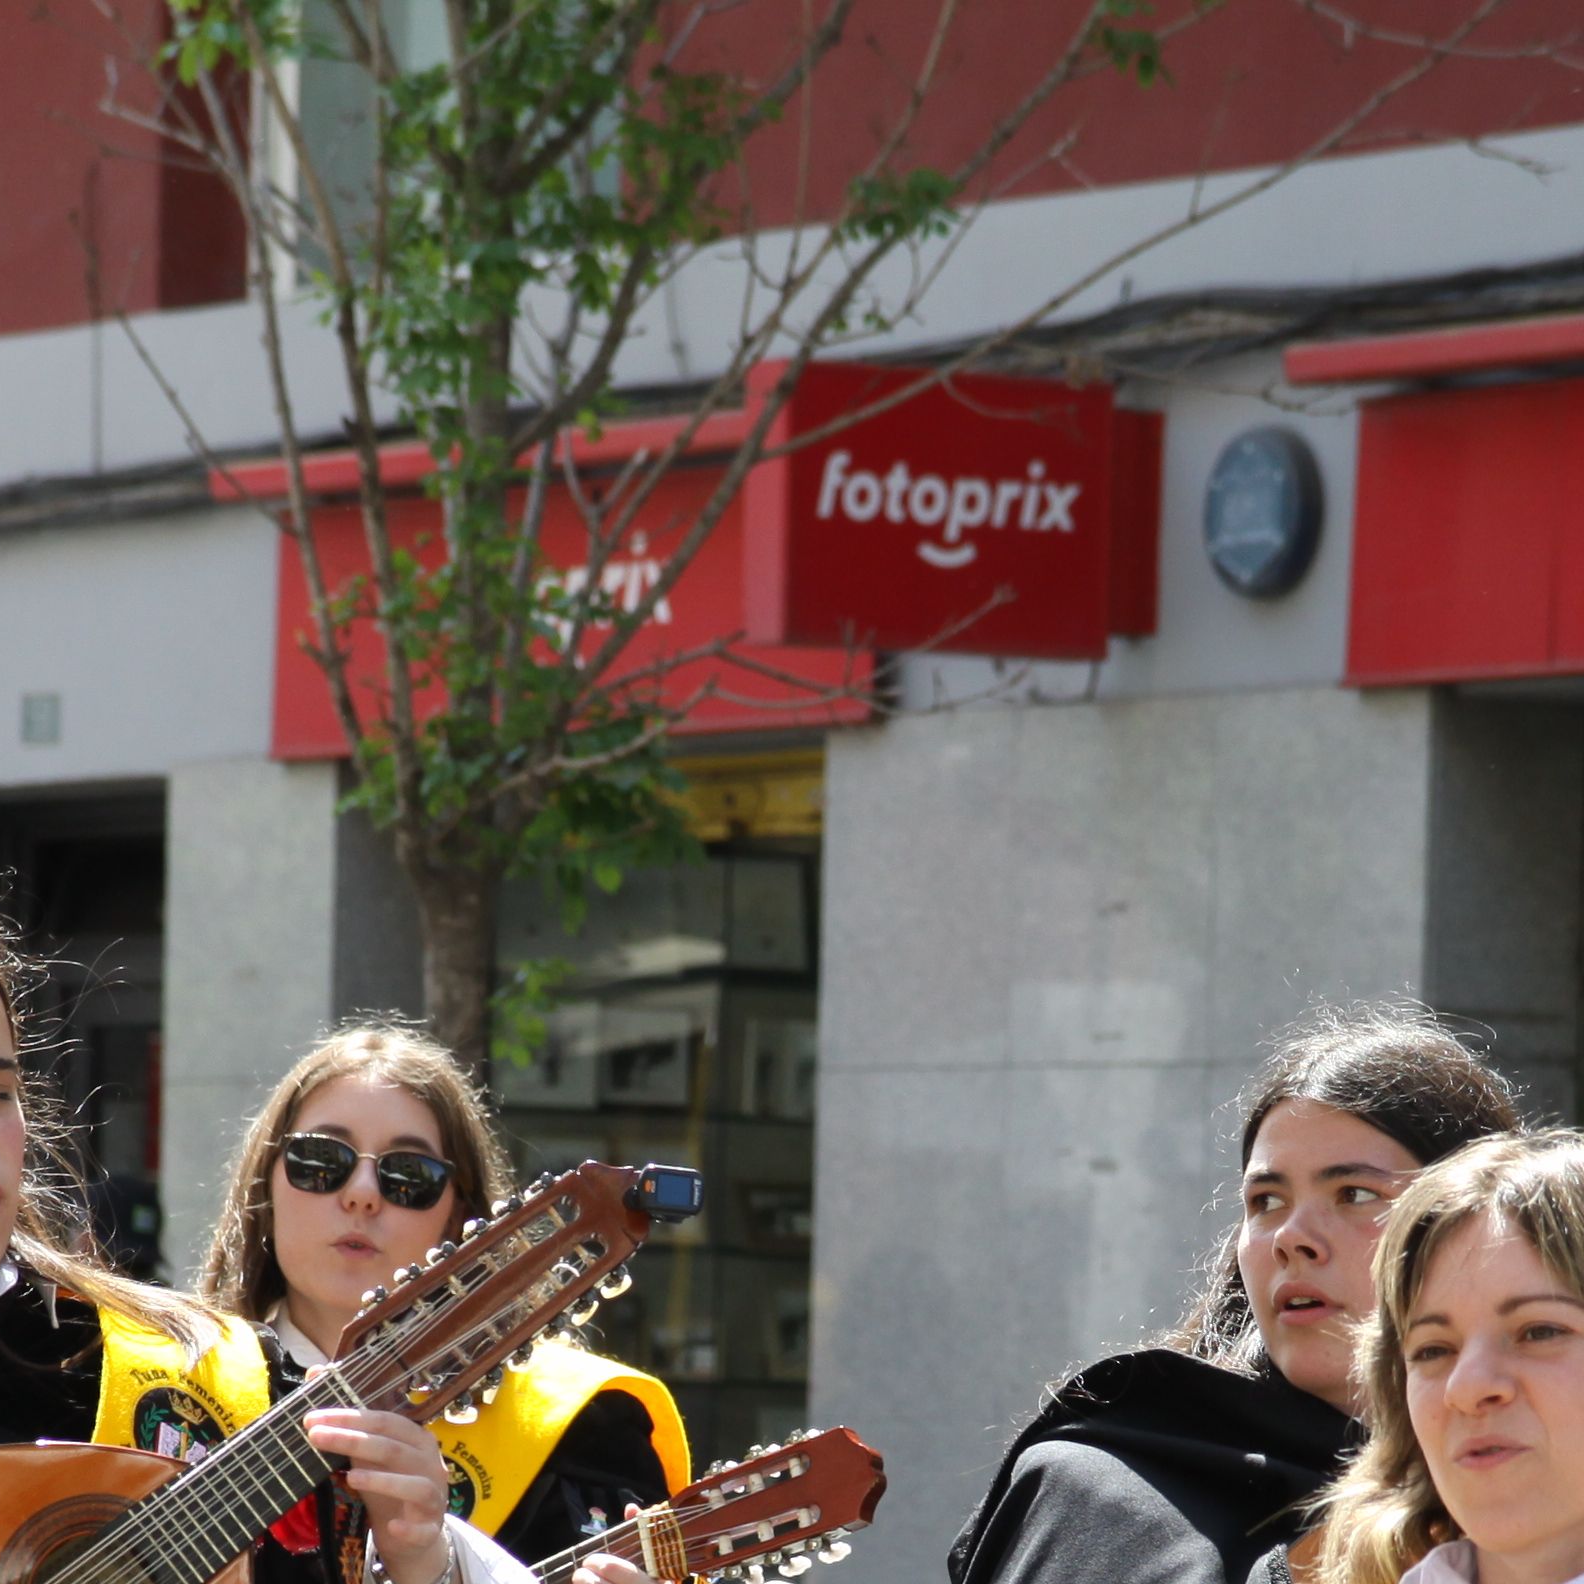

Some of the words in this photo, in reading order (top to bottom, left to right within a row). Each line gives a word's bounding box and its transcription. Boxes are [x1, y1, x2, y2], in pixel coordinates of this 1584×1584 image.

[817, 451, 1080, 541] fotoprix
[130, 1368, 169, 1386] Tuna
[178, 1369, 237, 1435] Femenin
